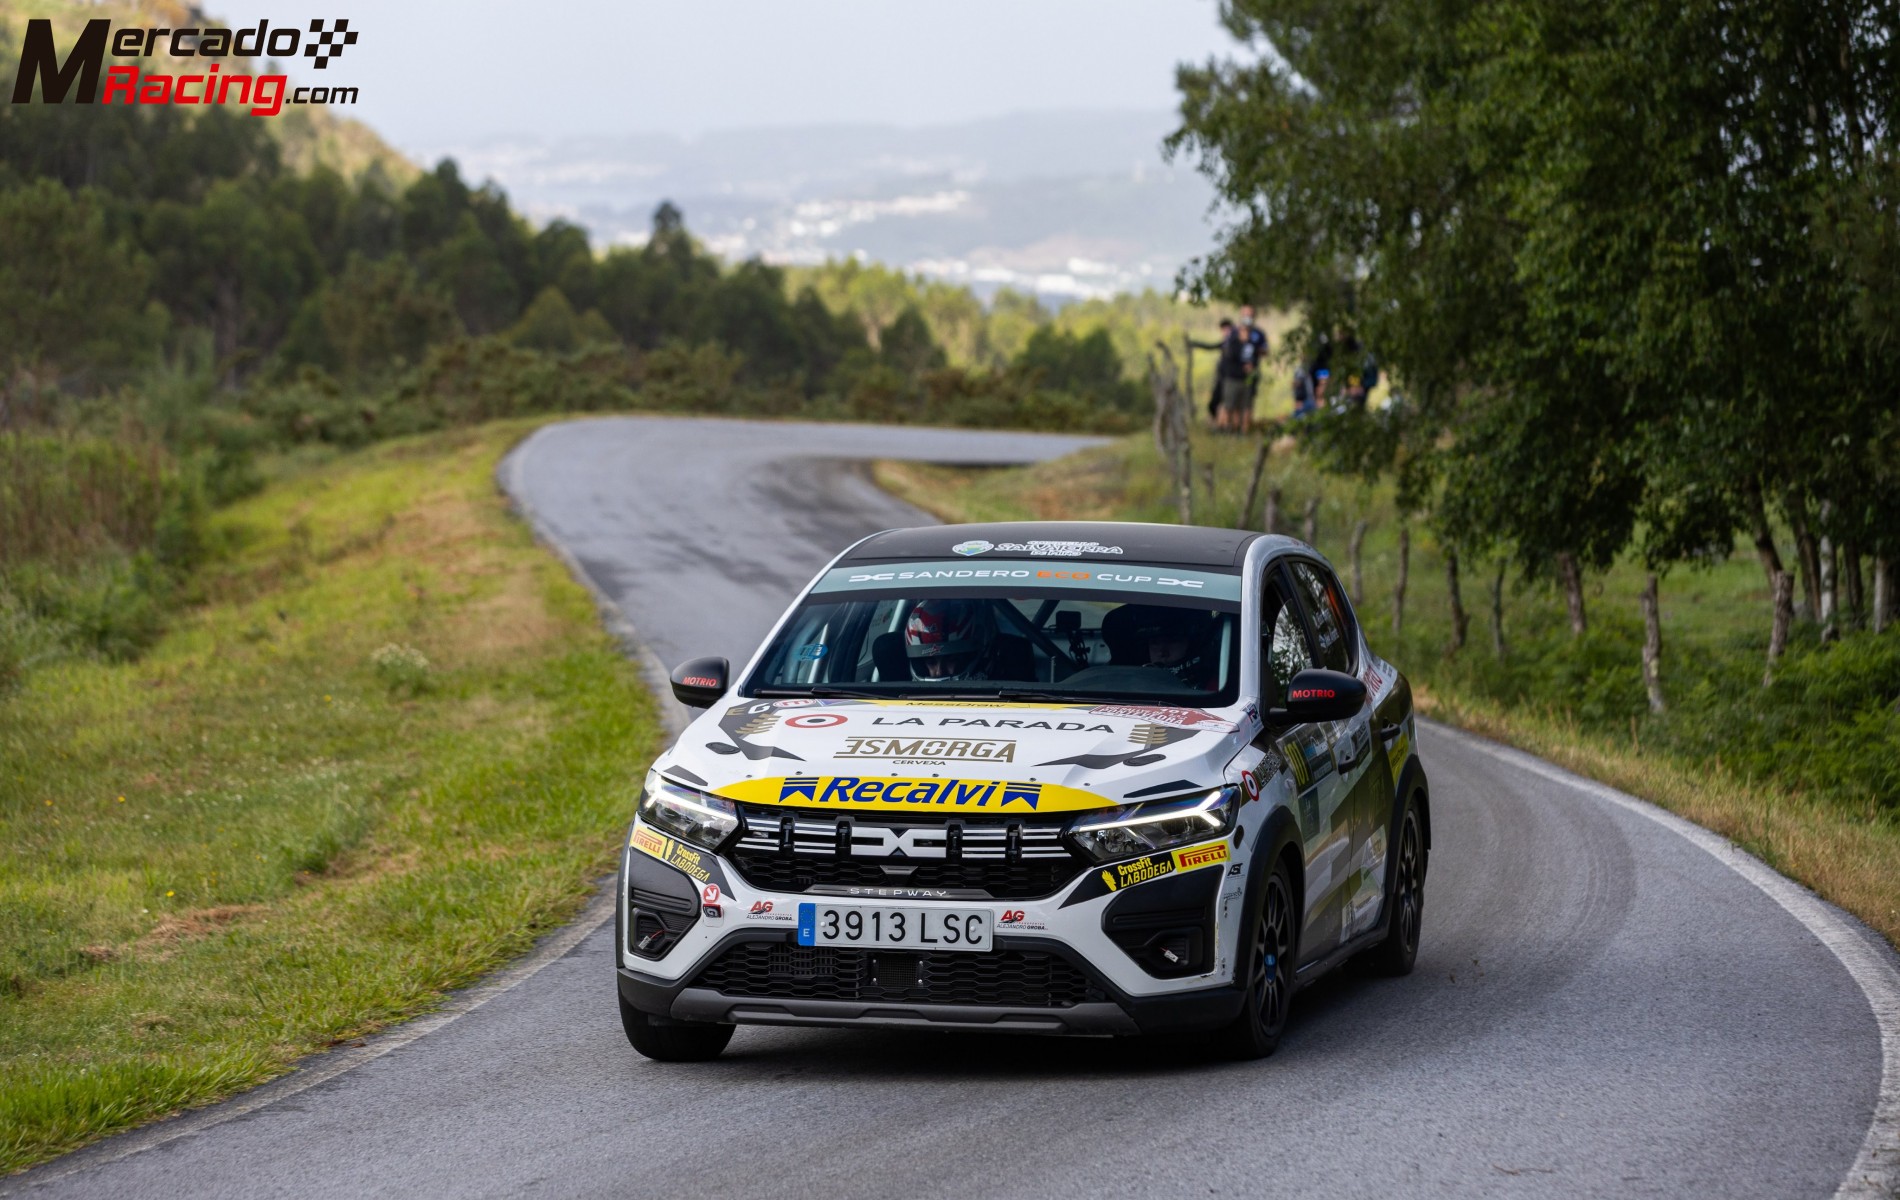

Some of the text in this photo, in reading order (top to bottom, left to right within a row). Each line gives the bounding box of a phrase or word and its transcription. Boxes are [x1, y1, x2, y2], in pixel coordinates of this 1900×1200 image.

[897, 569, 1152, 583] SANDERO ECO CUP
[682, 676, 717, 687] MOTRIO
[1292, 689, 1335, 698] MOTRIO
[872, 716, 1115, 733] LA PARADA
[818, 777, 1001, 806] Recalvi
[633, 829, 663, 854] PIRELLI
[676, 844, 701, 866] CrossFit
[1178, 845, 1227, 868] PIRELLI
[670, 854, 711, 882] LABODEGA
[1117, 857, 1153, 876] CrossFit
[1120, 861, 1173, 887] LABODEGA
[850, 888, 947, 897] STEPWAY
[750, 901, 774, 913] AG
[1000, 910, 1025, 922] AG
[803, 928, 810, 937] E
[823, 909, 983, 945] 3913 LSC
